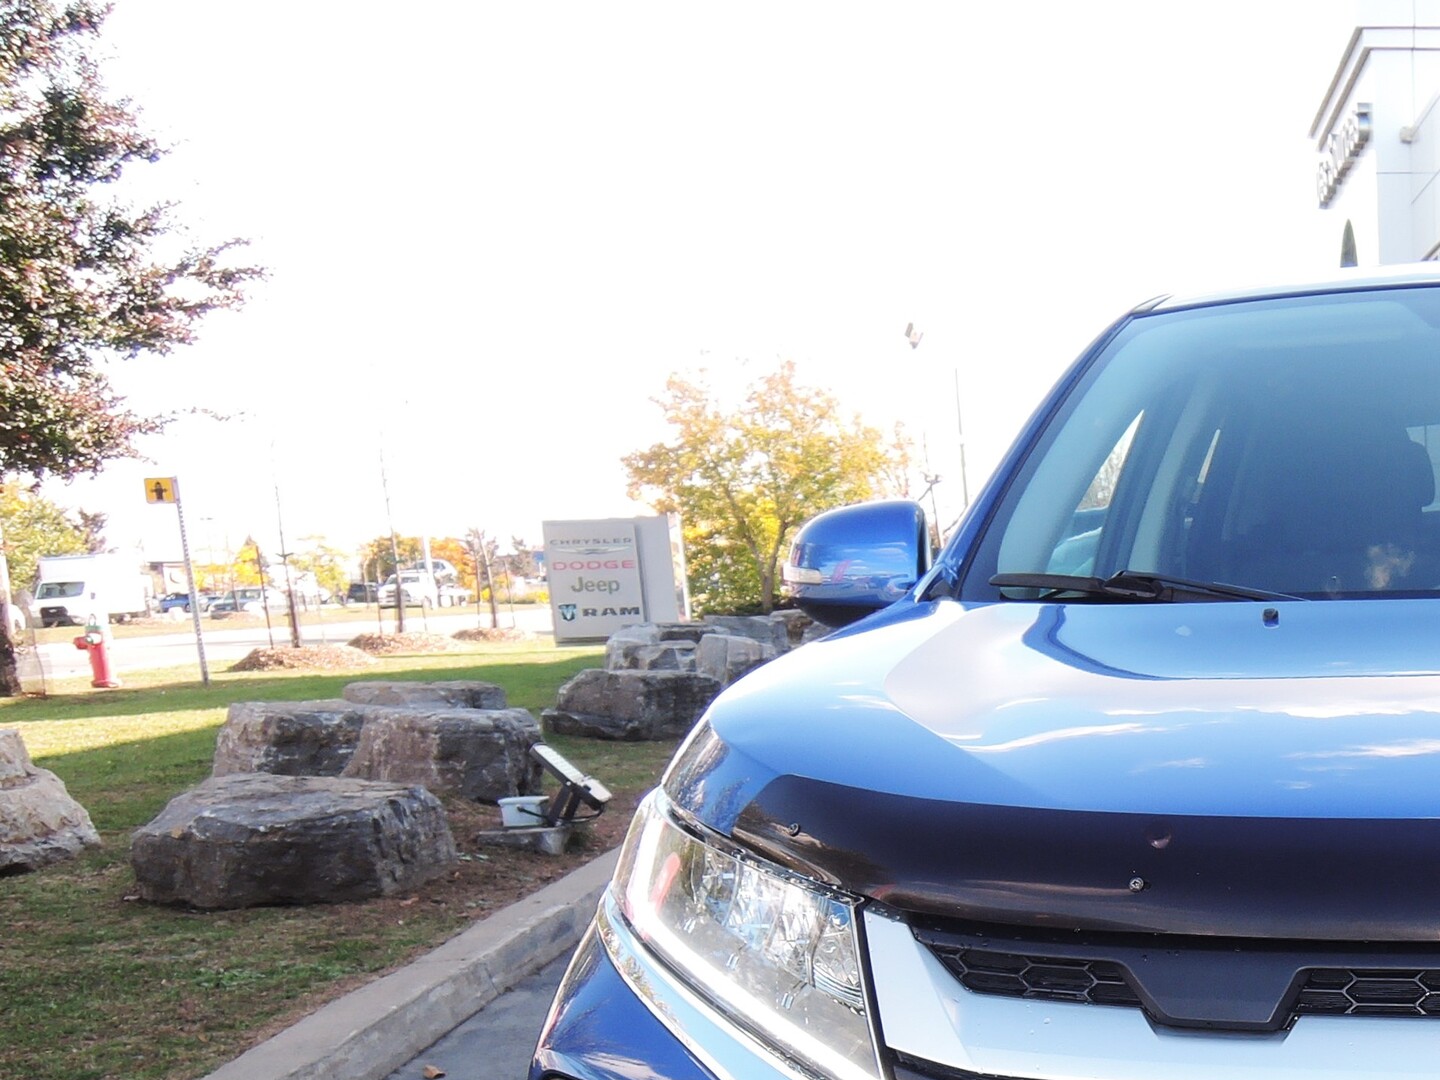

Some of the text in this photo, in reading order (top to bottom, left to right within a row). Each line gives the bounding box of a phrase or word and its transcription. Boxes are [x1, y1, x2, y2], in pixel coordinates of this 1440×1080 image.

[550, 537, 632, 545] CHRYSLER
[552, 560, 635, 570] DODGE
[570, 576, 621, 595] Jeep
[582, 606, 640, 617] RAM
